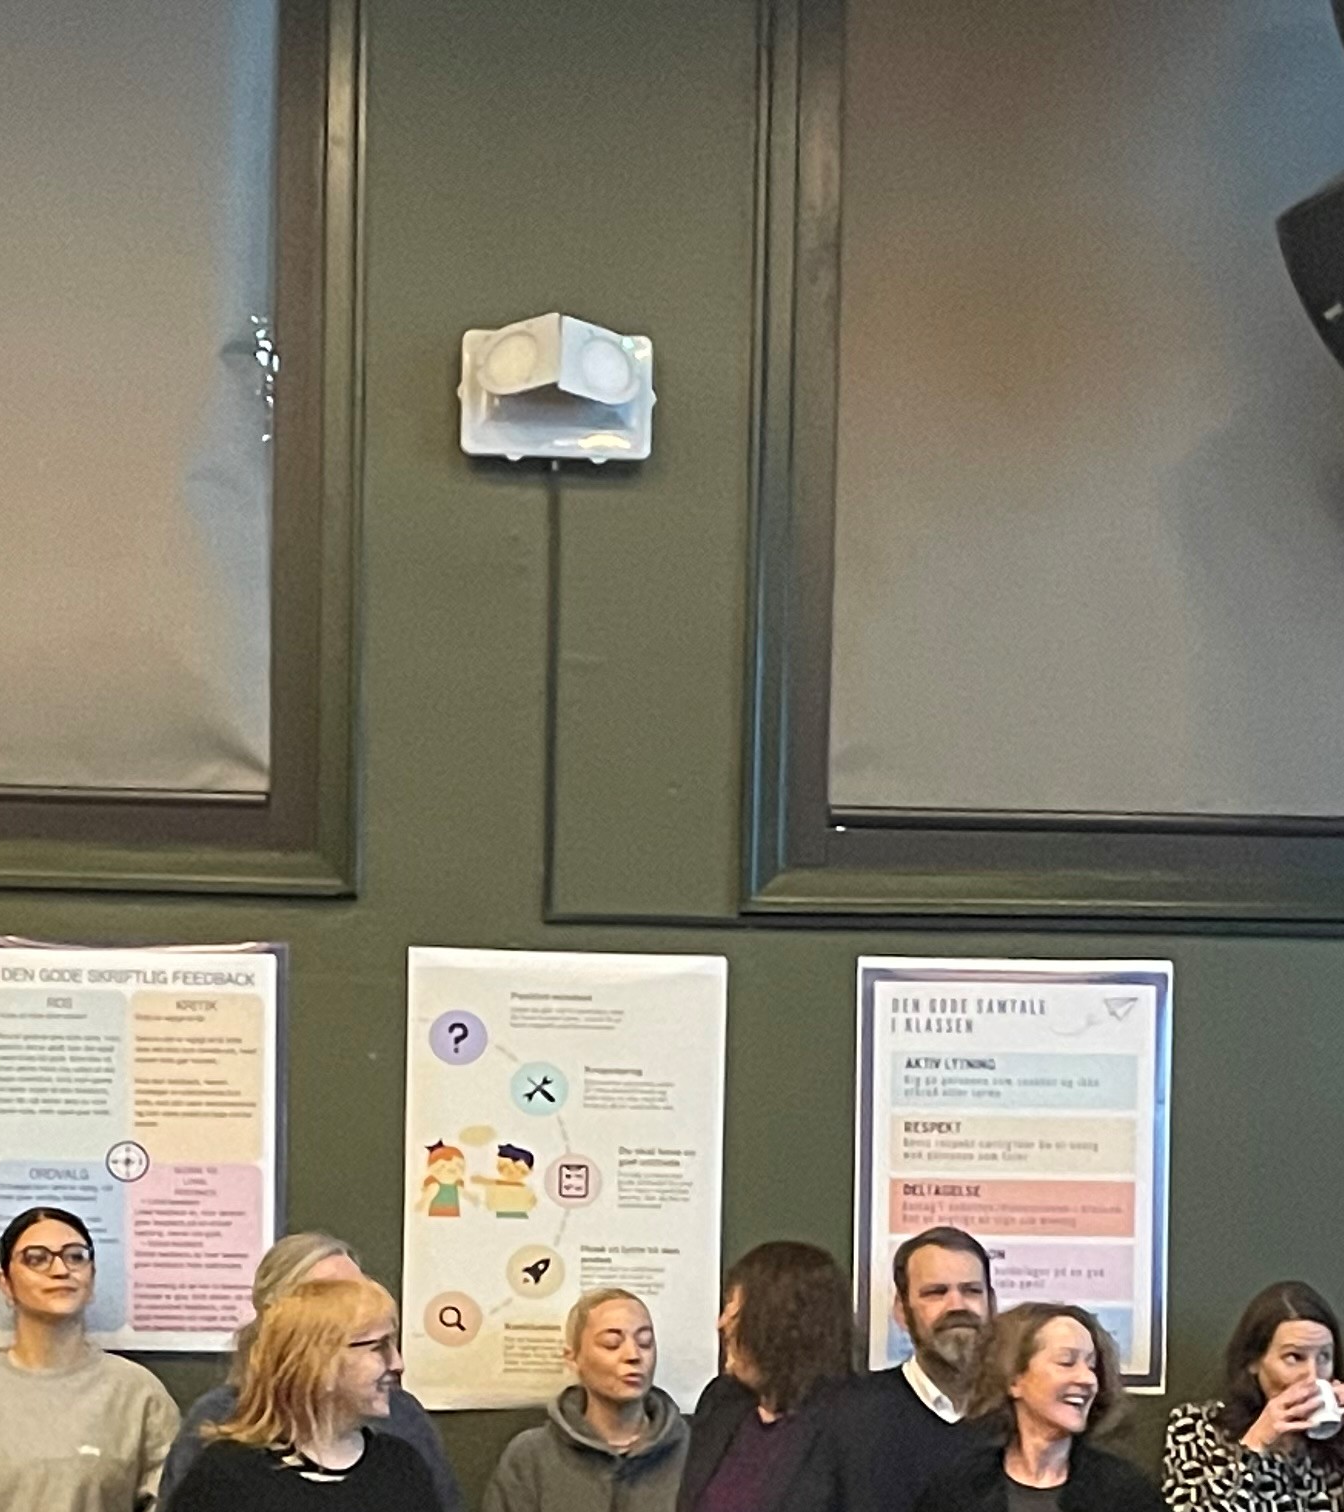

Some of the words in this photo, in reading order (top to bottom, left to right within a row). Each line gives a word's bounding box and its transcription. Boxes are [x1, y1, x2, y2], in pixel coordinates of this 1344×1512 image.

[1, 967, 35, 982] DEN
[39, 968, 82, 984] GODE
[172, 971, 255, 986] FEEDBACK
[891, 998, 921, 1013] DEN
[928, 998, 968, 1014] GODE
[976, 998, 1046, 1015] SAMTALE
[905, 1017, 973, 1034] KLASSEN
[905, 1058, 940, 1070] AKTIV
[944, 1058, 996, 1071] LYTNING
[904, 1121, 961, 1134] RESPEKT
[29, 1168, 89, 1180] ORDVALG
[903, 1184, 981, 1197] DELTAGELSE
